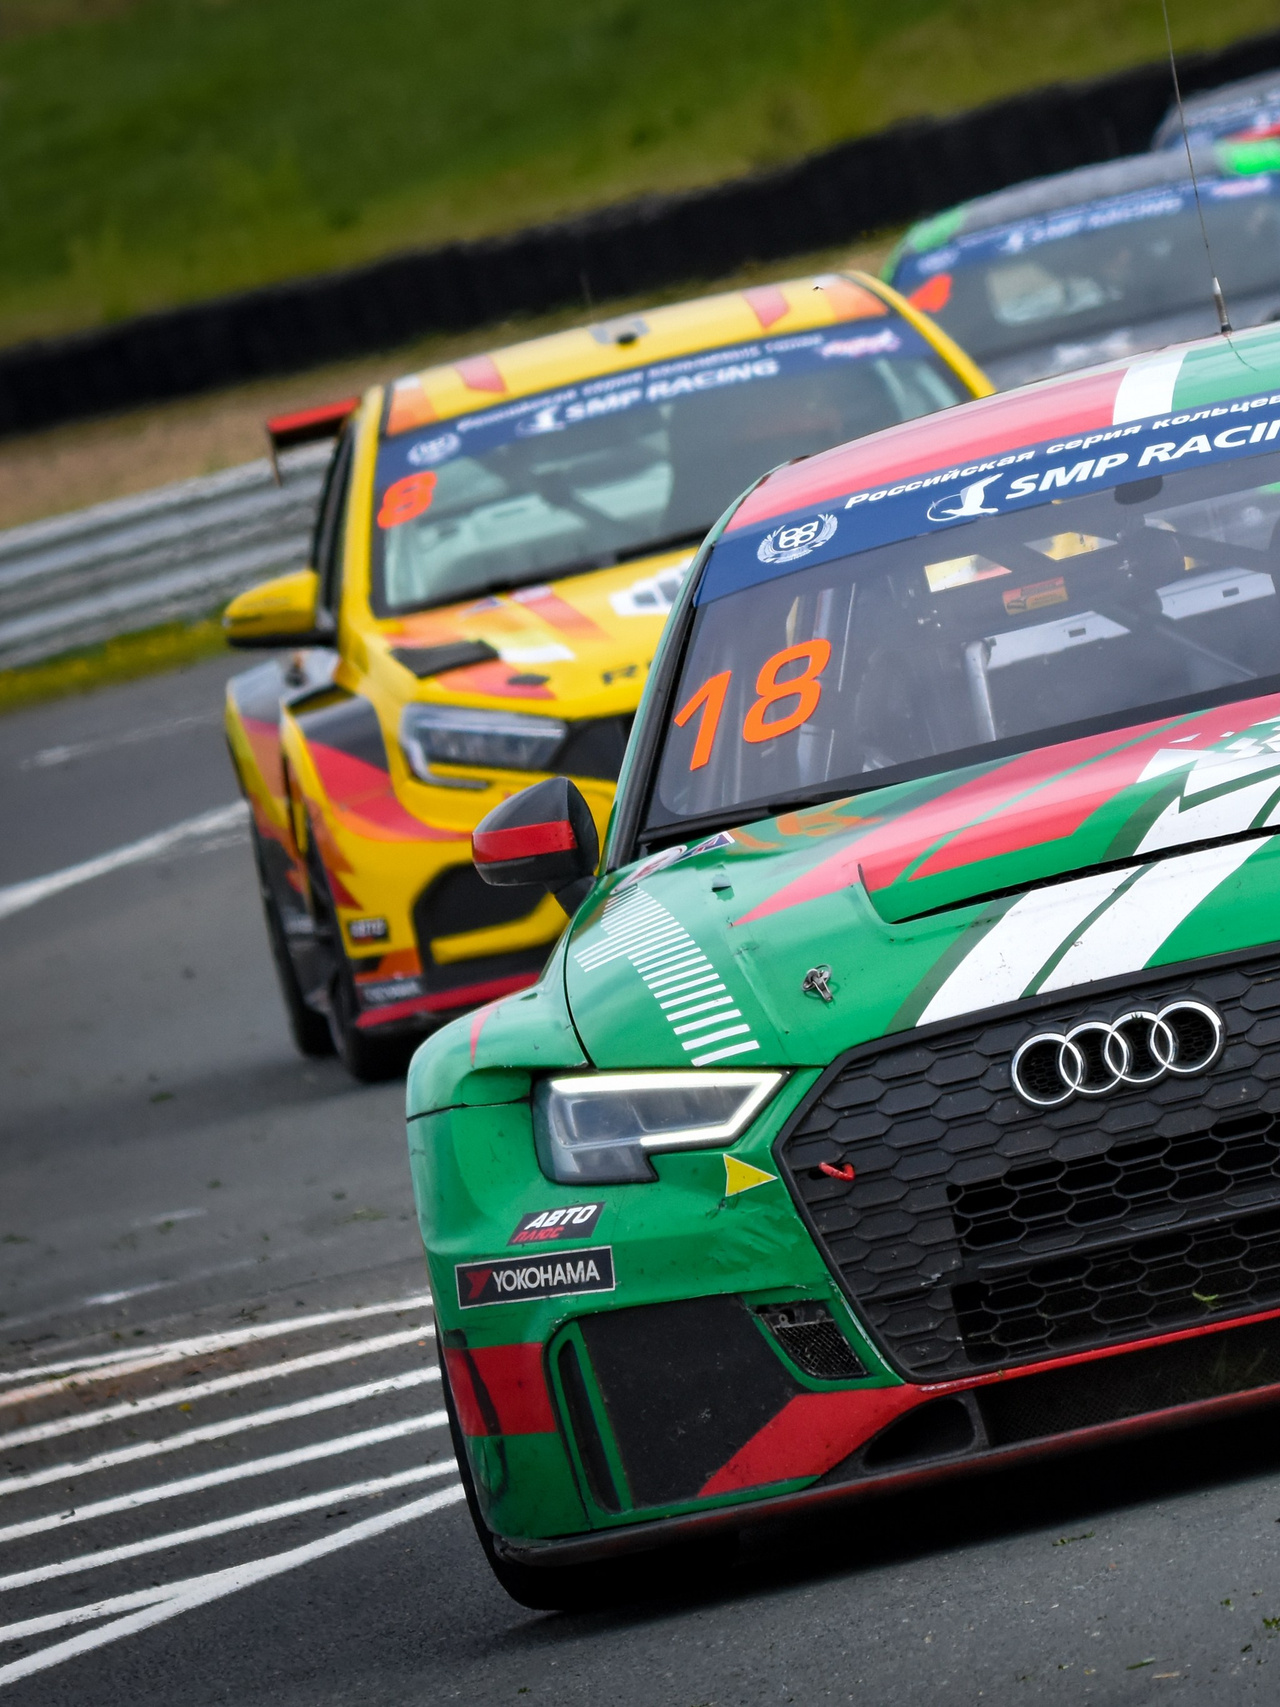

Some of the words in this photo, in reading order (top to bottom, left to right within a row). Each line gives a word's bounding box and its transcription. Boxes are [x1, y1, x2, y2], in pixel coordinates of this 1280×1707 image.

[844, 450, 1035, 509] Российская
[1046, 425, 1142, 455] серия
[1005, 452, 1129, 500] SMP
[377, 471, 438, 530] 8
[673, 638, 831, 771] 18
[512, 1226, 565, 1243] ПЛЮС
[524, 1204, 597, 1230] АВТО
[492, 1259, 601, 1293] YOKOHAMA
